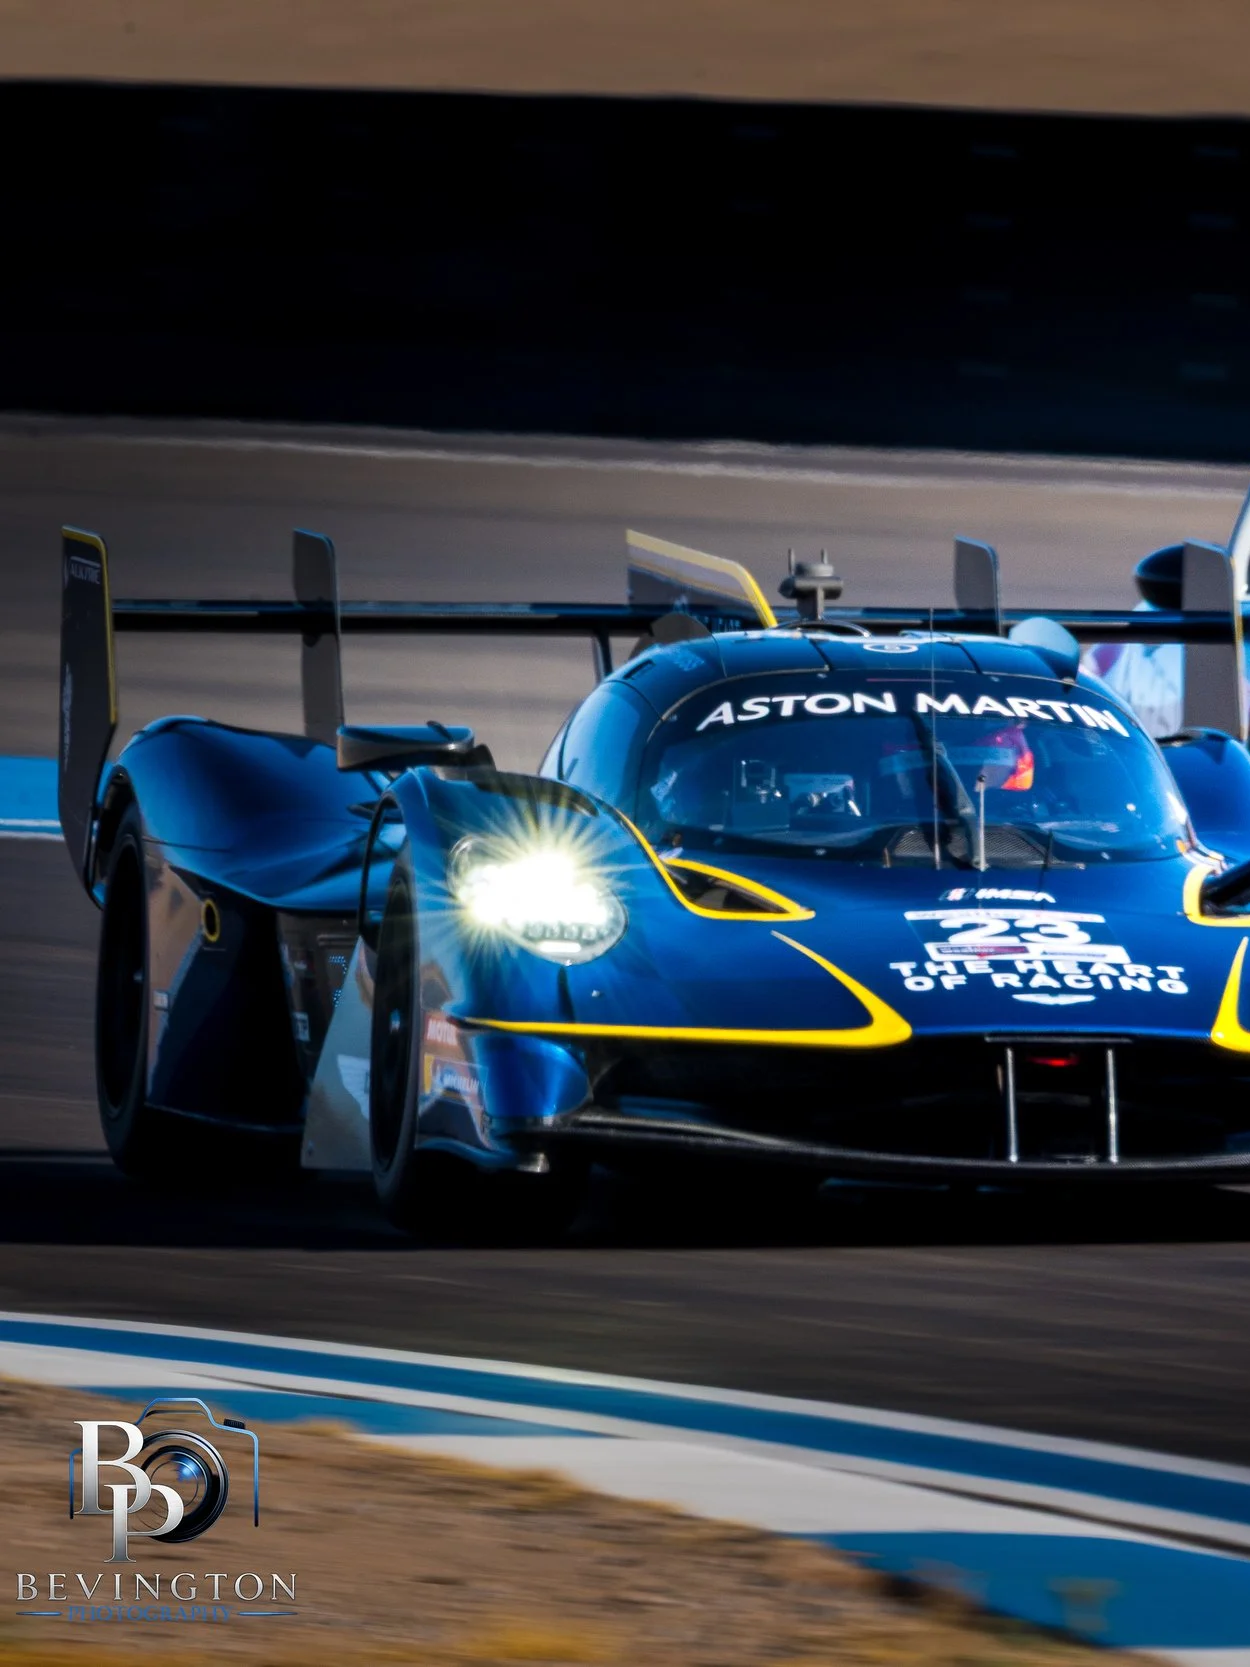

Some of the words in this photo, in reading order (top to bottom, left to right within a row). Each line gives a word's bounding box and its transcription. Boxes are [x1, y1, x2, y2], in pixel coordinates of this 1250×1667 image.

[697, 691, 897, 731] ASTON
[912, 692, 1130, 738] MARTIN
[939, 919, 1091, 945] 23
[889, 961, 995, 977] THE
[1013, 960, 1185, 980] HEART
[904, 977, 969, 991] OF
[991, 974, 1189, 994] RACING
